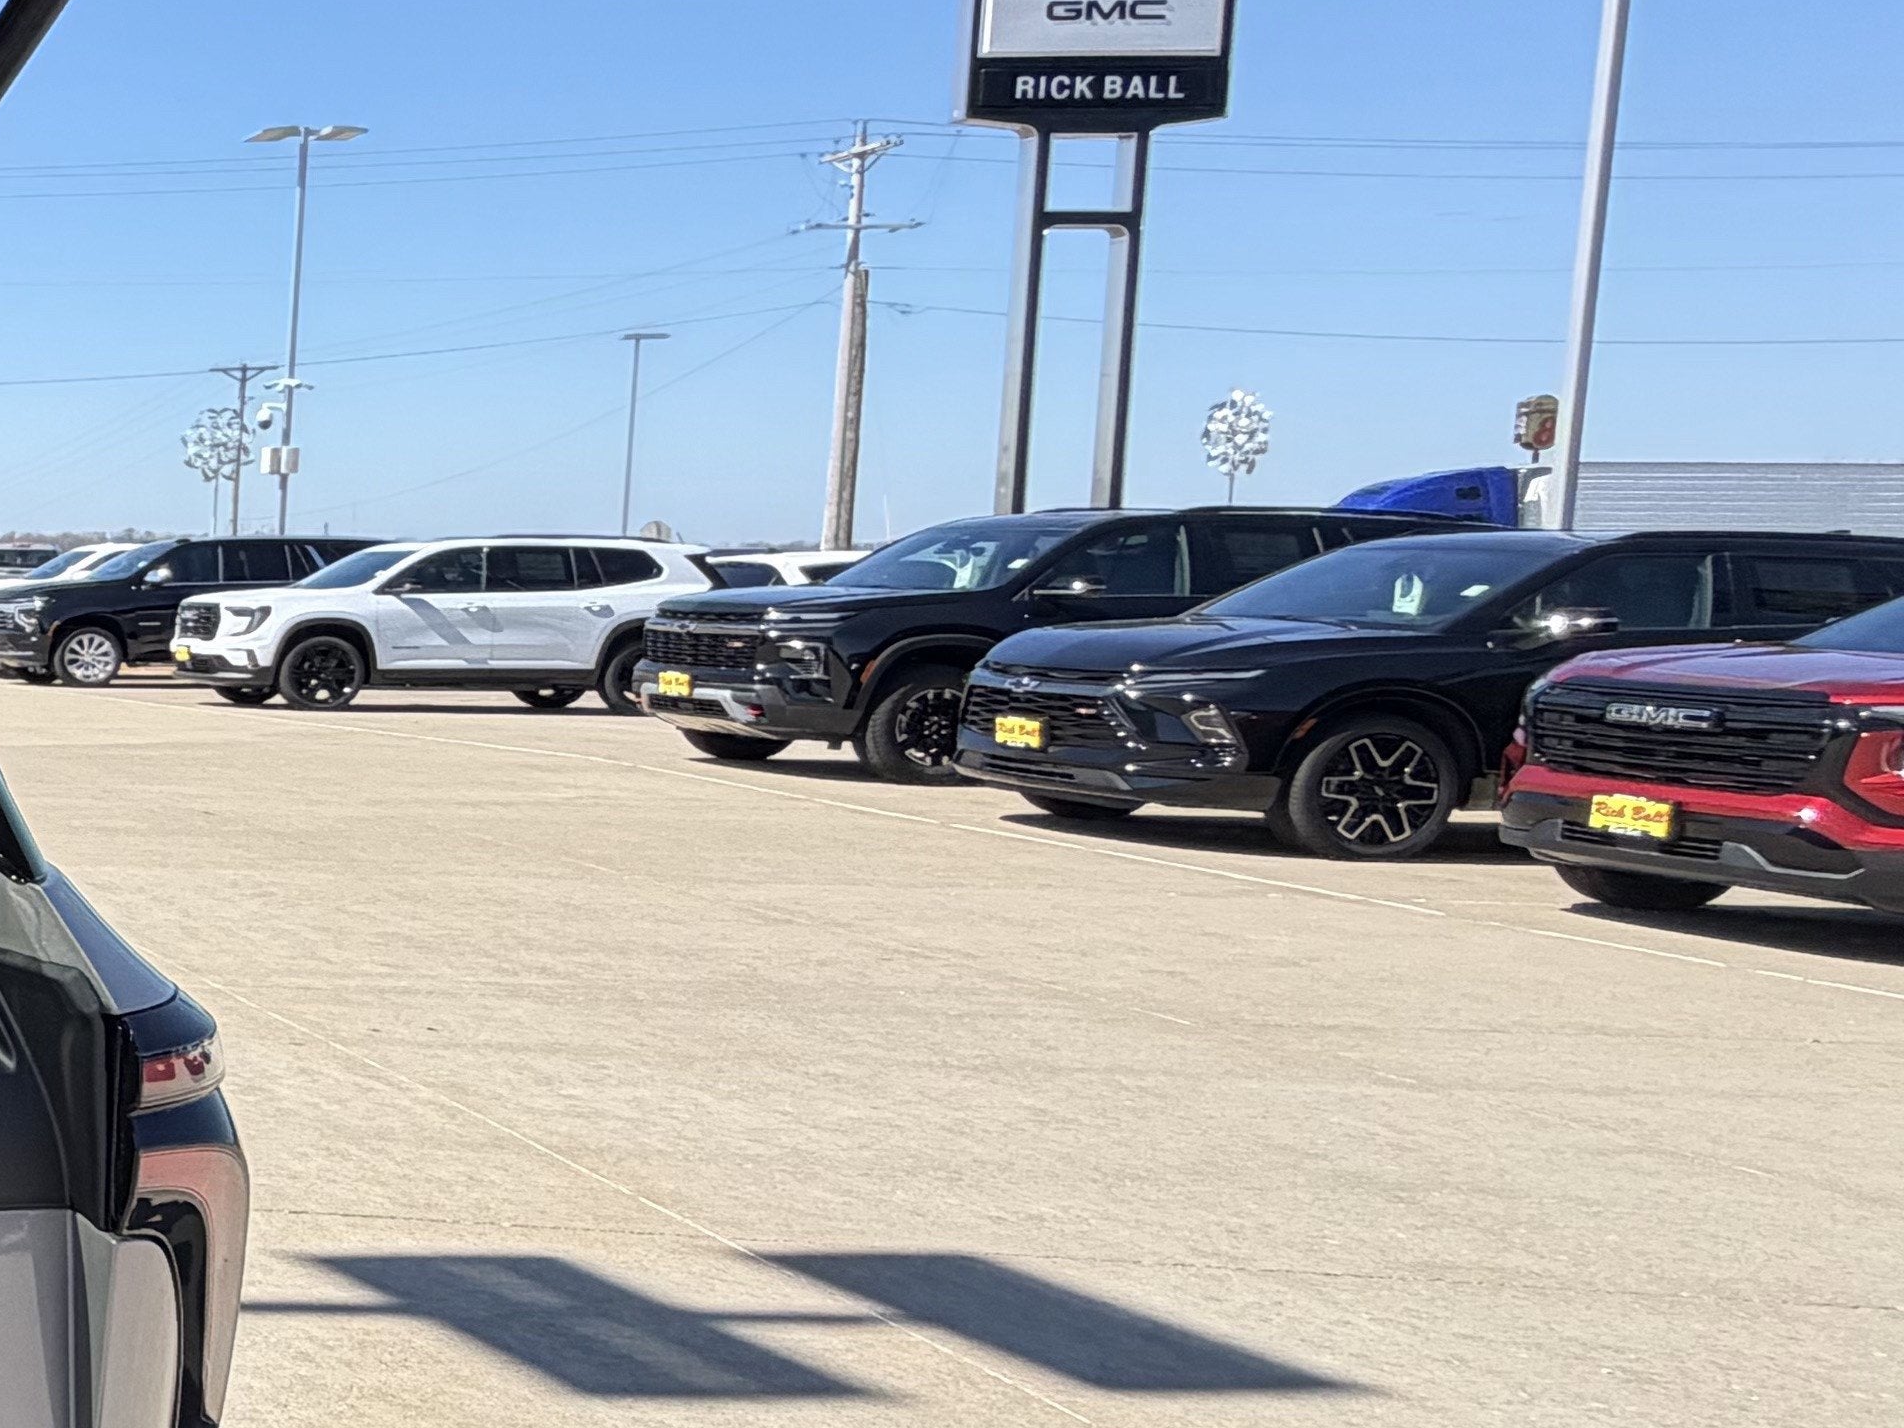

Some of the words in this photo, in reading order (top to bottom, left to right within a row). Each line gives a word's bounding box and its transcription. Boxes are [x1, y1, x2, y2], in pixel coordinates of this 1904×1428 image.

[1046, 0, 1168, 22] GMC
[1014, 75, 1096, 100] RICK
[1103, 75, 1185, 100] BALL
[1605, 702, 1713, 729] GMC
[1594, 800, 1627, 819] Rick
